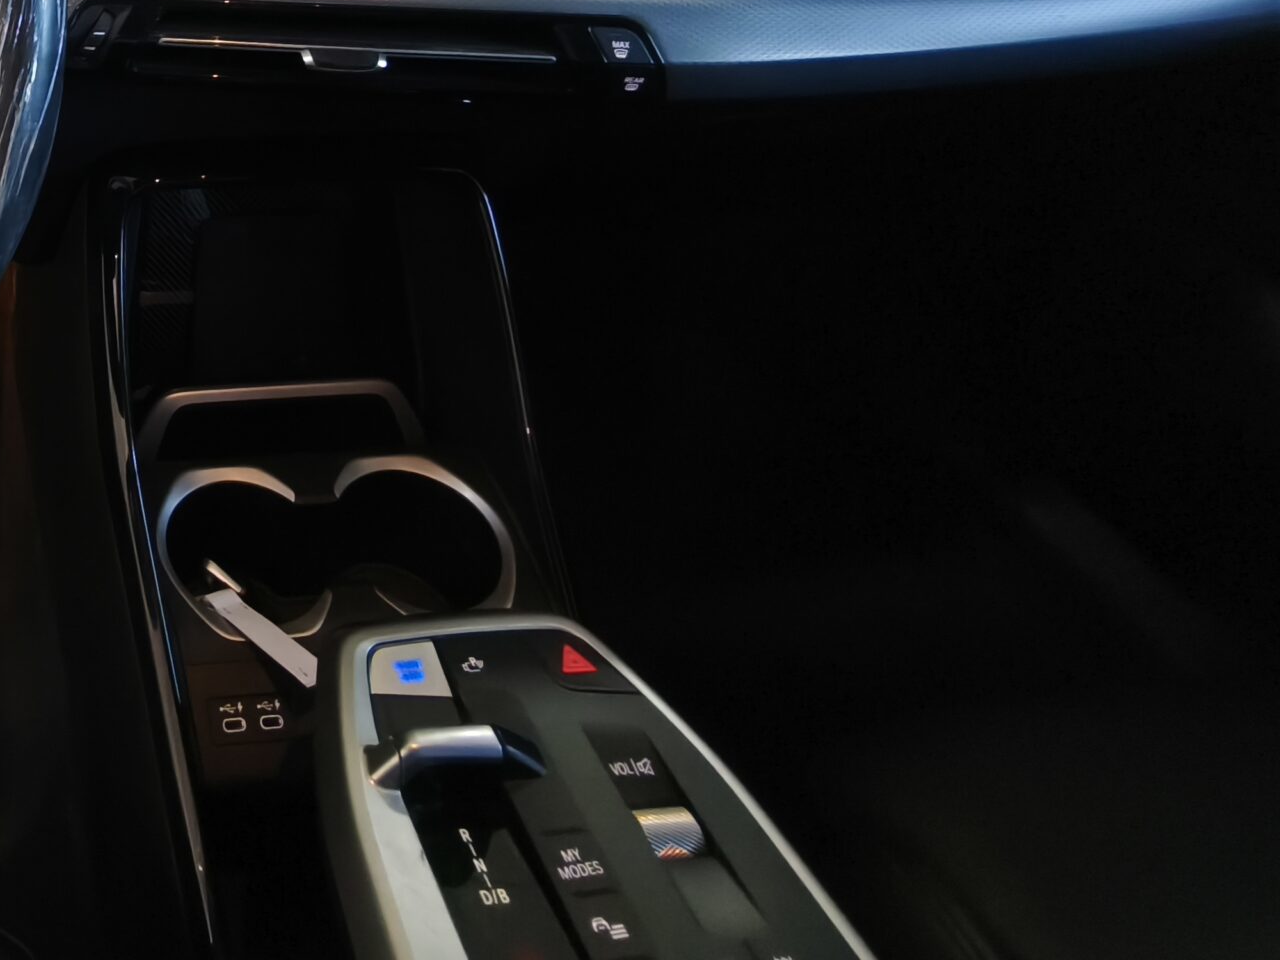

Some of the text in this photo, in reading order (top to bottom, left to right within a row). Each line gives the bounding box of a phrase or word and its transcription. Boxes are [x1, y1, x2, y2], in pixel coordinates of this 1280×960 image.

[611, 40, 630, 49] MAX
[608, 761, 634, 776] VOL
[458, 828, 473, 842] R
[560, 847, 582, 863] MY
[472, 858, 488, 873] N
[556, 860, 604, 881] MODES
[478, 888, 511, 906] D/B
